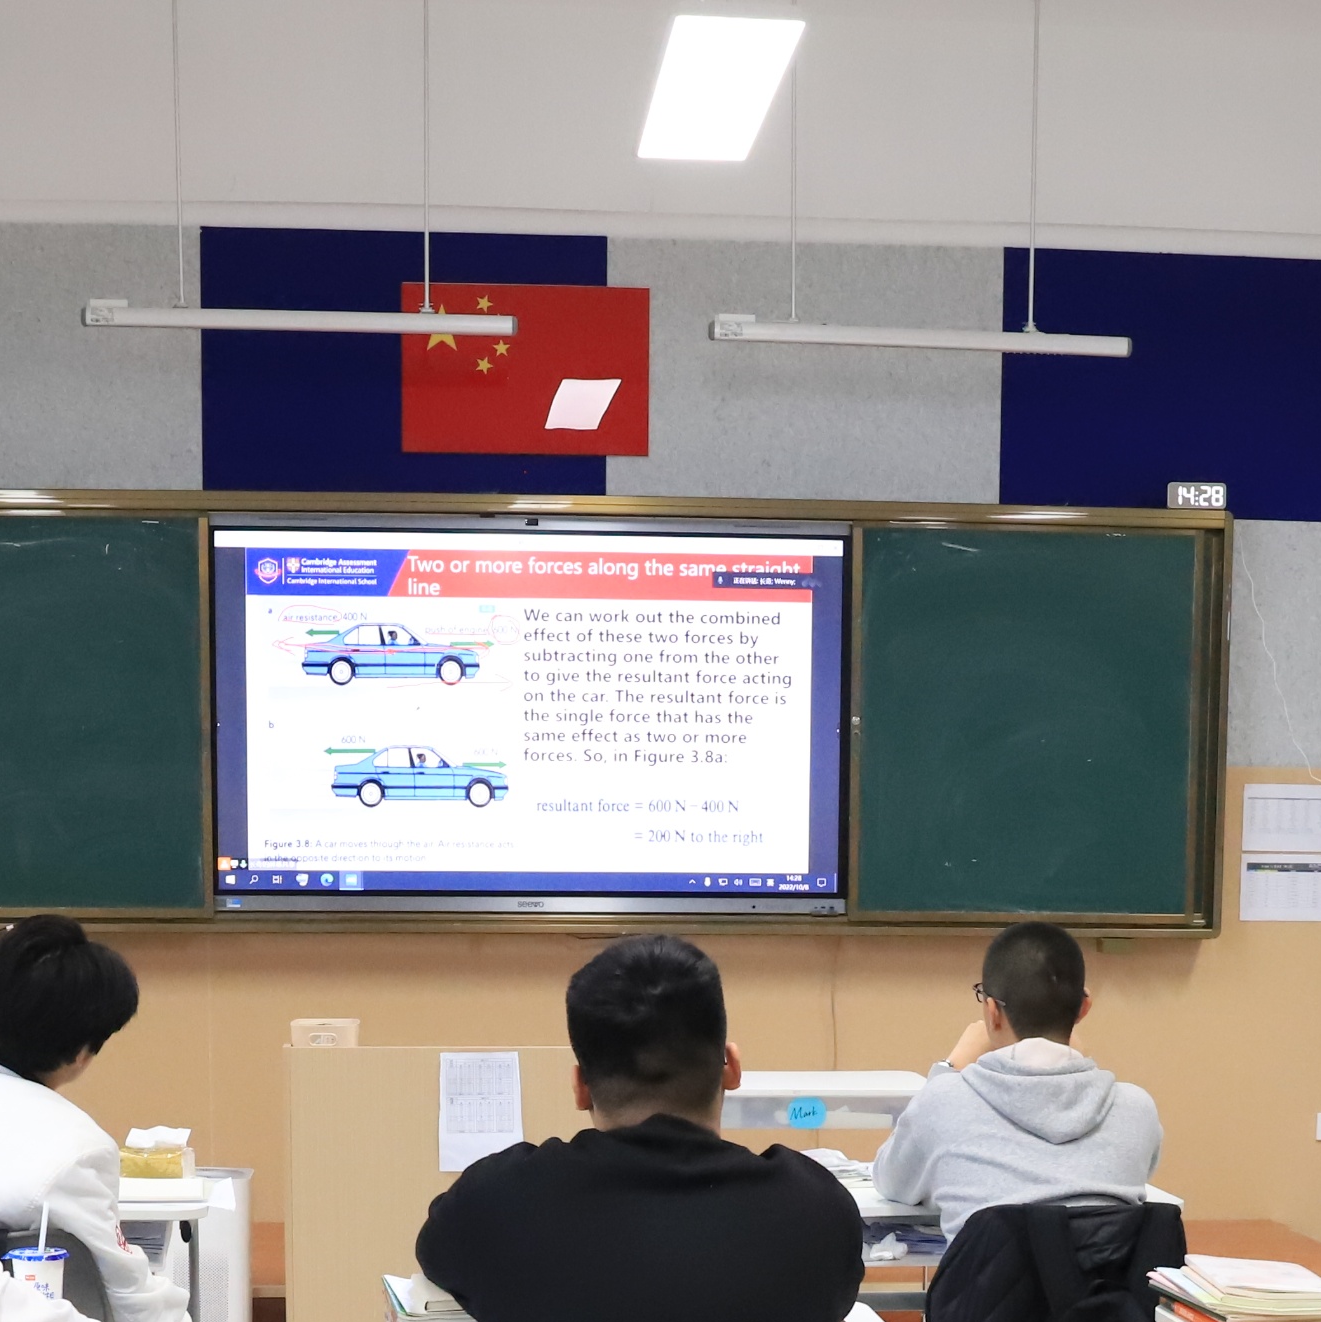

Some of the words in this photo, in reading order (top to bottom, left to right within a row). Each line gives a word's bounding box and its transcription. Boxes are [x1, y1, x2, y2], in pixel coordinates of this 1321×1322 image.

[1178, 486, 1223, 506] 14:28
[301, 558, 337, 567] Cambridge
[408, 555, 445, 573] Two
[450, 560, 470, 573] or
[475, 560, 523, 574] more
[528, 556, 582, 575] forces
[588, 558, 639, 580] along
[644, 558, 674, 576] the
[679, 562, 727, 577] same
[287, 578, 317, 586] Cambridge
[407, 577, 441, 596] line
[343, 613, 358, 621] 400
[524, 609, 549, 621] We
[556, 613, 582, 621] can
[590, 610, 628, 622] work
[636, 612, 662, 623] out
[669, 611, 694, 623] the
[701, 612, 780, 625] combined
[524, 628, 570, 641] effect
[577, 629, 593, 642] of
[599, 630, 642, 642] these
[649, 632, 678, 643] two
[685, 630, 733, 644] forces
[740, 632, 758, 648] by
[525, 649, 616, 666] subtracting
[624, 654, 653, 662] one
[660, 650, 697, 663] from
[705, 651, 729, 664] the
[736, 652, 778, 664] other
[524, 671, 539, 681] to
[547, 669, 579, 685] give
[586, 669, 611, 682] the
[618, 670, 689, 683] resultant
[696, 670, 736, 683] force
[743, 672, 791, 688] acting
[524, 693, 543, 701] on
[550, 689, 575, 701] the
[582, 693, 609, 702] car.
[616, 690, 643, 702] The
[651, 691, 721, 703] resultant
[729, 691, 768, 704] force
[776, 692, 786, 704] is
[524, 709, 549, 721] the
[556, 709, 603, 725] single
[610, 709, 650, 722] force
[657, 710, 687, 723] that
[695, 711, 721, 723] has
[728, 711, 752, 724] the
[341, 736, 357, 744] 600
[359, 735, 366, 743] N
[525, 733, 565, 741] same
[572, 729, 617, 742] effect
[624, 733, 640, 742] as
[647, 732, 676, 742] two
[683, 734, 698, 743] or
[706, 734, 746, 743] more
[524, 748, 576, 761] forces.
[584, 749, 606, 763] So,
[614, 751, 627, 761] in
[635, 750, 684, 766] Figure
[692, 750, 726, 763] 3.8a:
[537, 800, 592, 811] resultant
[599, 799, 629, 812] force
[649, 800, 671, 811] 600
[676, 800, 685, 812] N
[702, 801, 723, 812] 400
[729, 801, 738, 812] N
[264, 840, 293, 850] Figure
[296, 840, 313, 848] 3.8:
[649, 830, 670, 842] 200
[675, 830, 685, 841] N
[691, 833, 703, 842] to
[709, 831, 727, 842] the
[733, 831, 762, 845] right
